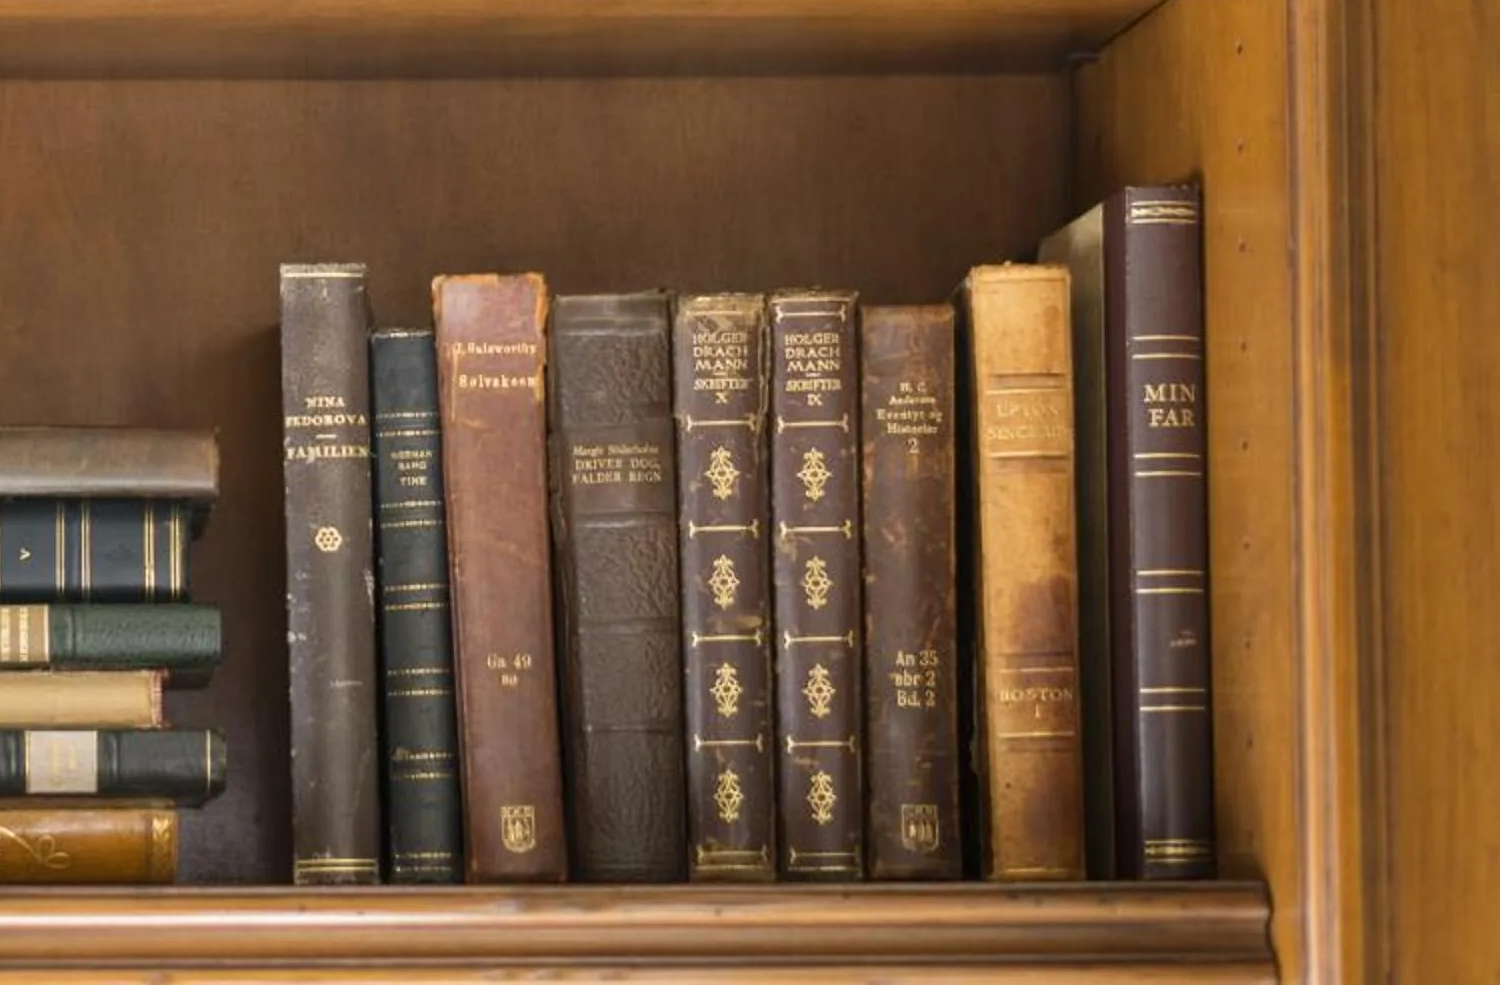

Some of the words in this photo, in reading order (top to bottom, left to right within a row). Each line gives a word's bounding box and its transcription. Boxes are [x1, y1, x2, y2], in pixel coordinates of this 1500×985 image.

[693, 332, 748, 345] HOLGER
[784, 333, 839, 345] HOLGER
[693, 346, 748, 358] DRACH
[784, 347, 840, 358] DRACH
[694, 359, 747, 371] MANN
[786, 359, 840, 371] MANN
[786, 378, 841, 391] SKRIFTER
[715, 392, 728, 404] X
[807, 394, 823, 406] IX
[1144, 384, 1196, 403] MIN
[304, 396, 345, 408] NINA
[285, 413, 367, 427] FEDOROVA
[876, 409, 925, 423] Eventyr
[1148, 409, 1195, 427] FAR
[887, 423, 938, 434] Historier
[287, 444, 368, 461] FAMILIEN
[907, 439, 920, 454] 2
[575, 458, 622, 470] DRIVER
[572, 471, 621, 484] FALDER
[629, 470, 661, 482] REGN
[895, 651, 915, 666] An
[919, 651, 939, 666] 35
[999, 688, 1073, 704] BOSTON
